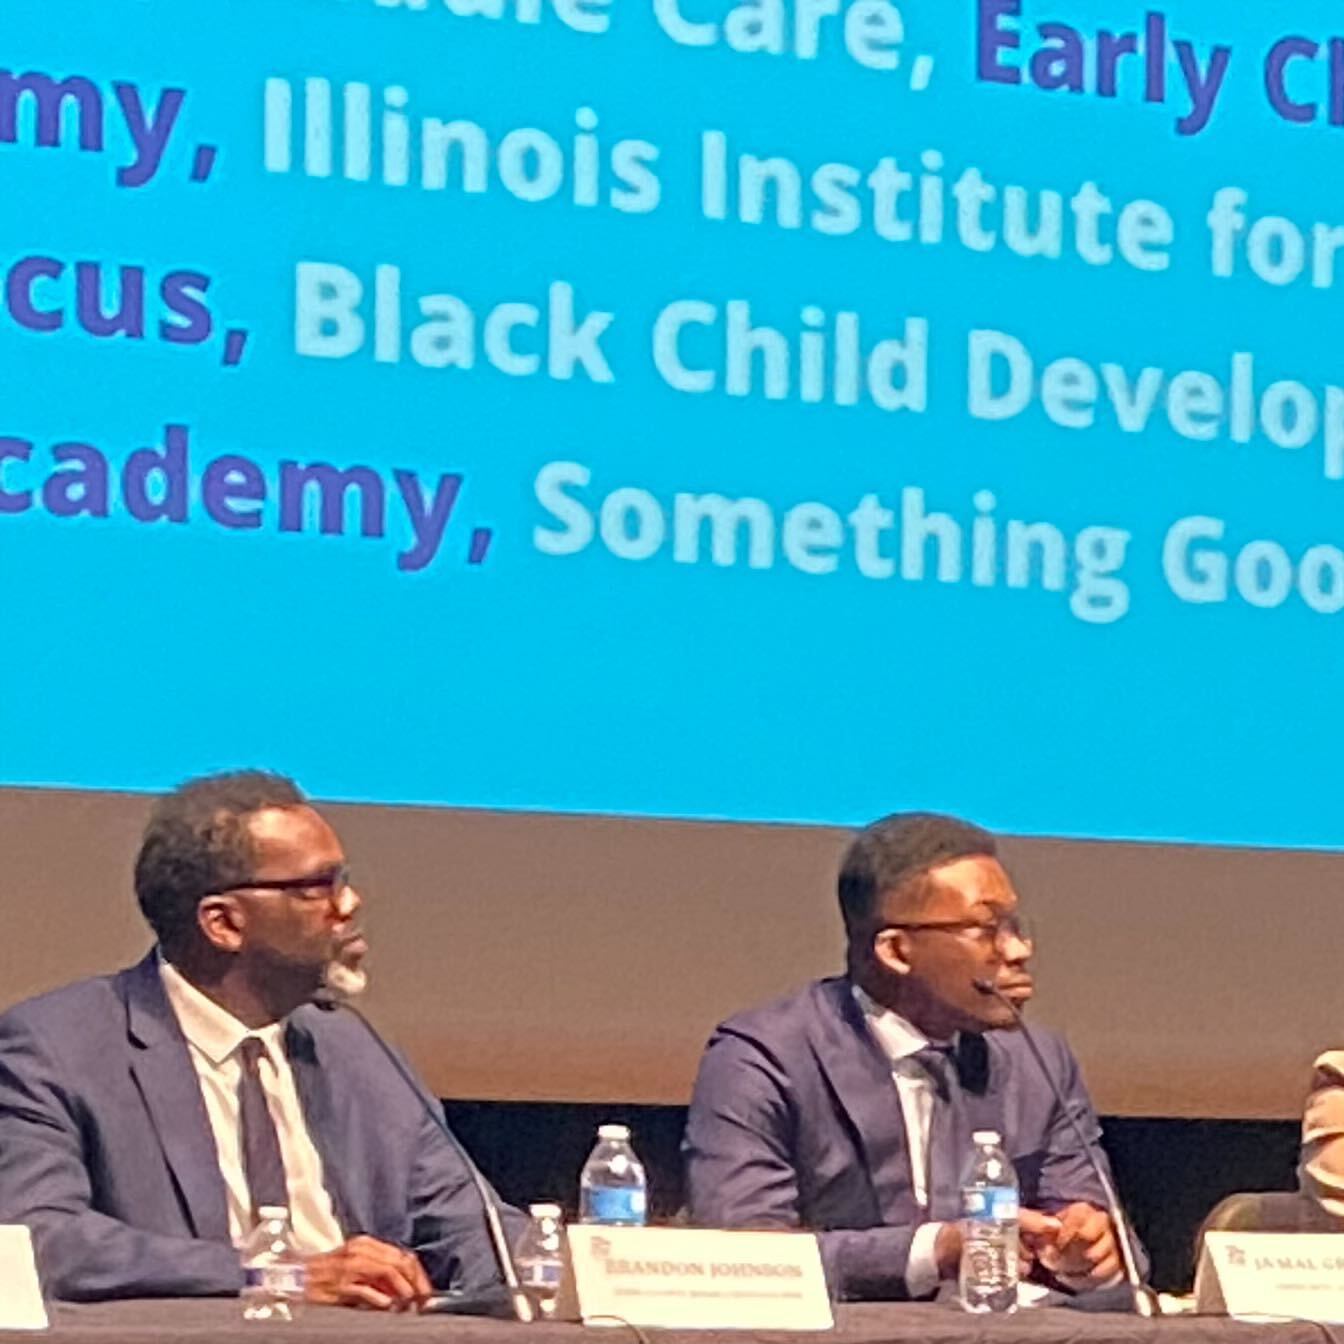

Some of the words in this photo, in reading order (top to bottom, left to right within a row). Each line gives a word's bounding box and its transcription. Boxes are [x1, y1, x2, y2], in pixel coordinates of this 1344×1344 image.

[975, 0, 1233, 138] Early
[263, 77, 662, 214] Illinois
[701, 130, 1174, 271] Institute
[4, 254, 249, 368] cus,
[294, 261, 615, 384] Black
[652, 299, 928, 412] Child
[532, 461, 1131, 624] Something
